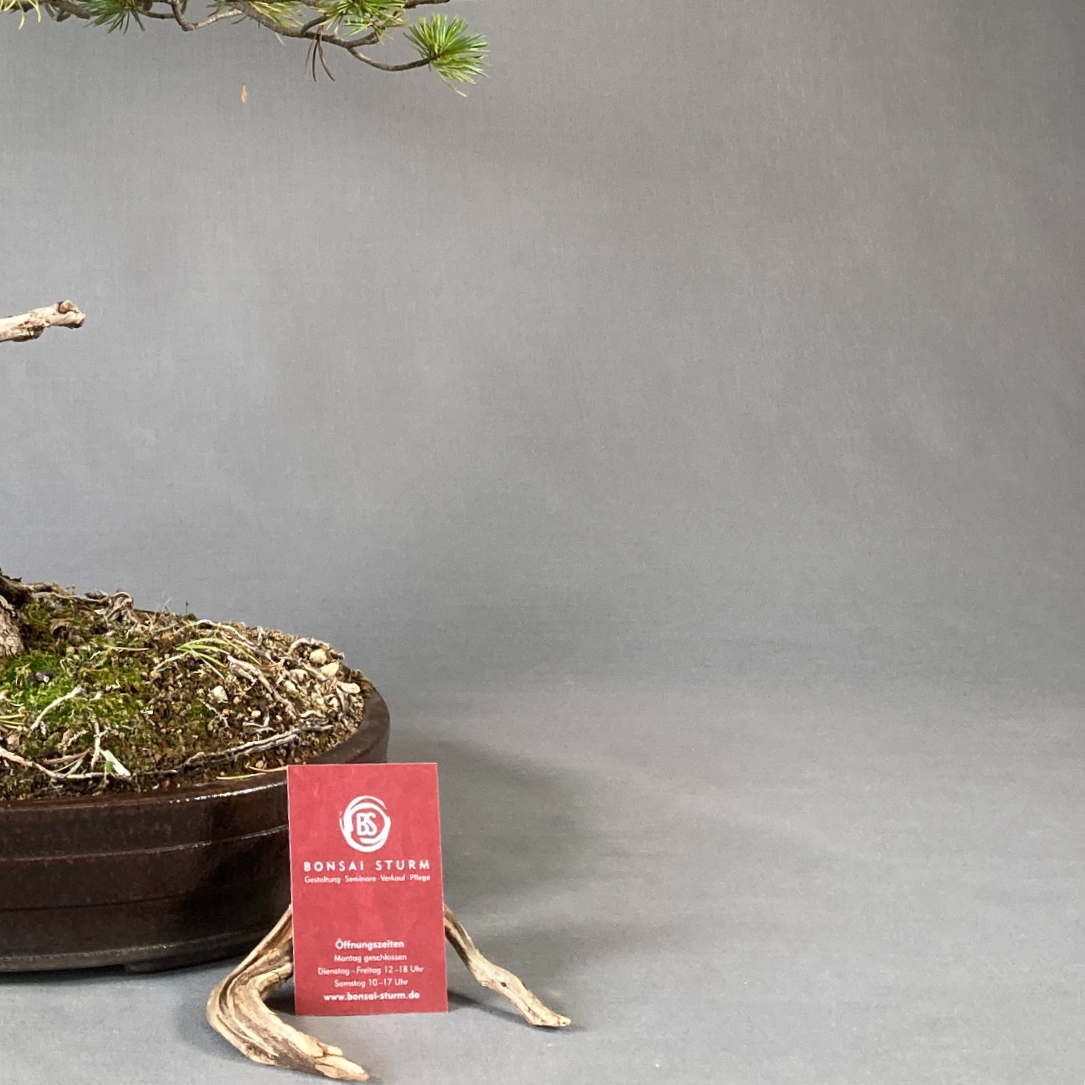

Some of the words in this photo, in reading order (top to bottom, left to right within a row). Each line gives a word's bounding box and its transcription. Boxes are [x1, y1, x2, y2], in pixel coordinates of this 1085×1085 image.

[356, 812, 378, 836] BS
[303, 860, 364, 872] BONSAI
[375, 859, 430, 870] STURM
[304, 875, 341, 884] Gestaltung
[380, 874, 405, 882] Verkauf
[410, 873, 431, 882] Pflege
[335, 938, 404, 951] Öffnungszeiten
[334, 955, 362, 963] Montag
[364, 953, 407, 963] geschlossen
[318, 967, 350, 976] Dienstag
[356, 966, 381, 975] Freitag
[410, 965, 424, 973] Uhr
[334, 979, 365, 988] Samstag
[395, 978, 408, 986] Uhr
[323, 990, 420, 1001] www.bonsai-sturm.de
